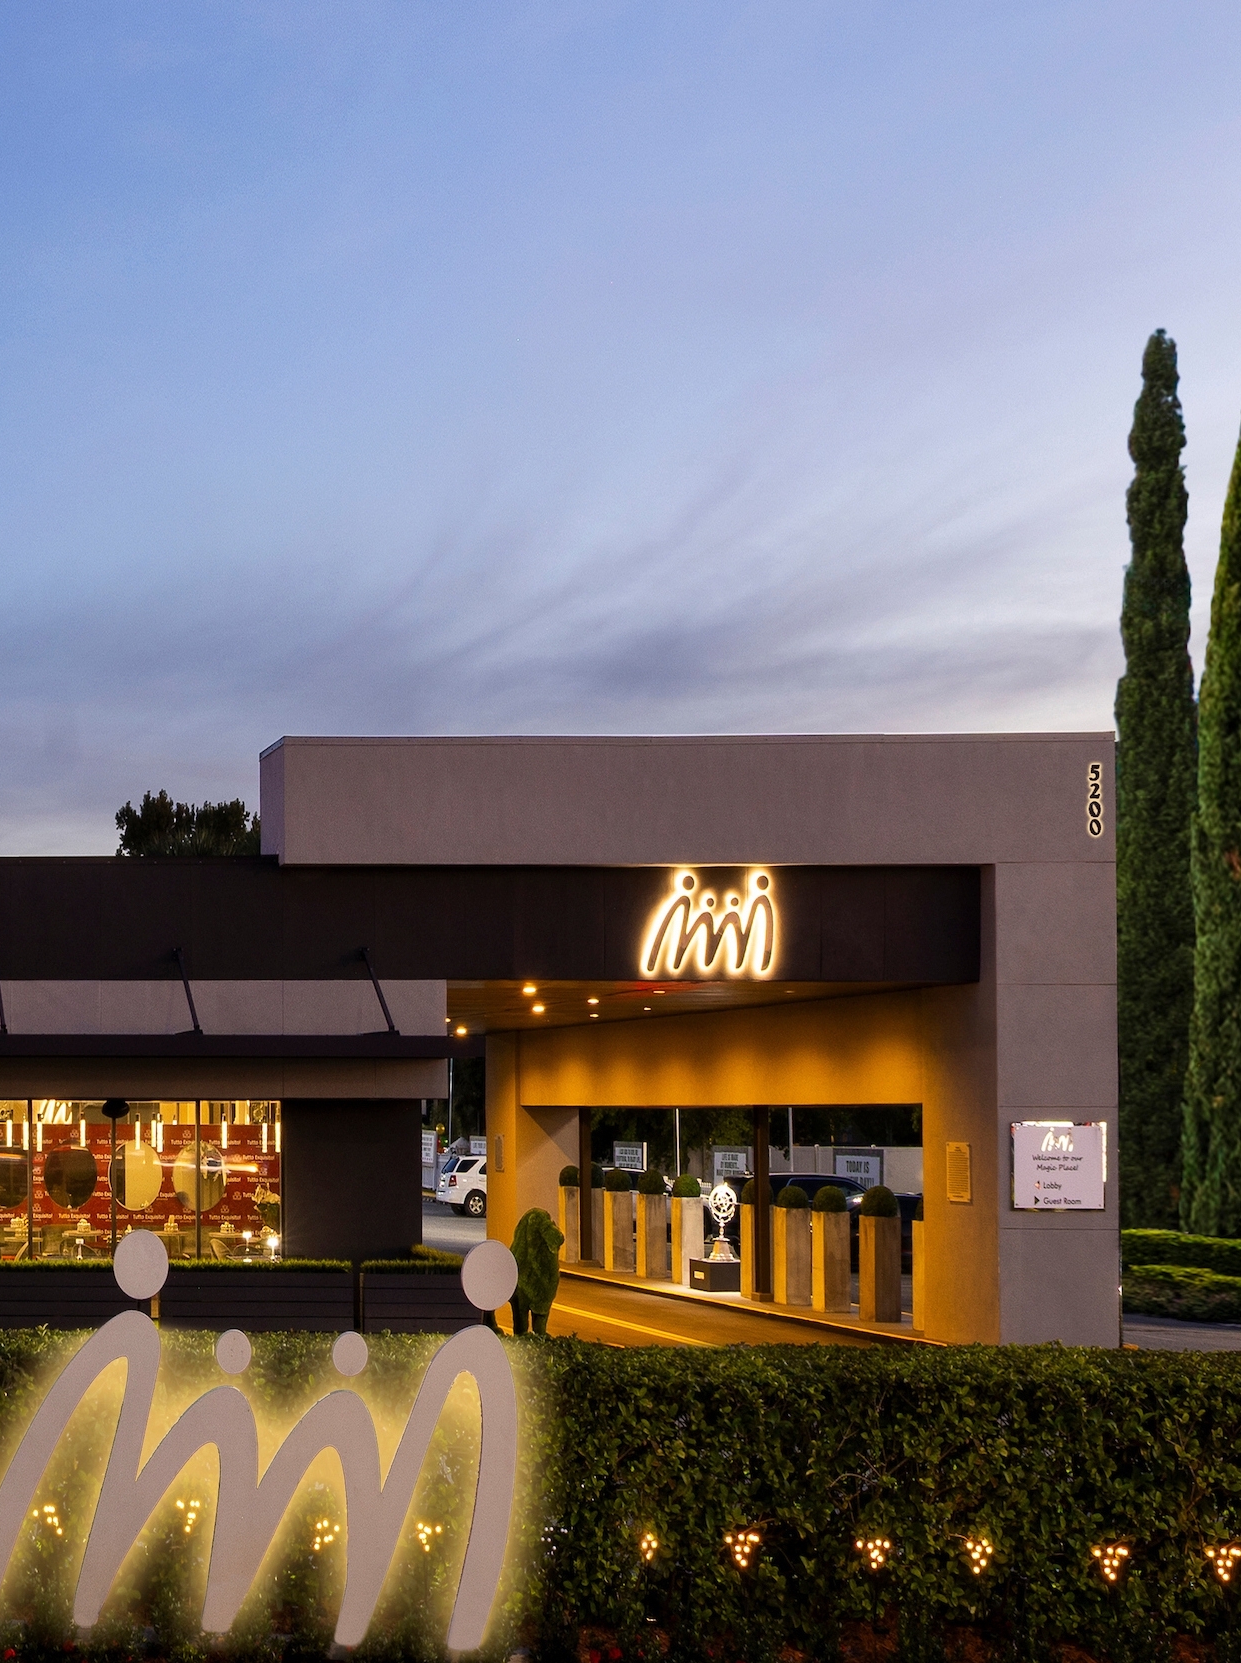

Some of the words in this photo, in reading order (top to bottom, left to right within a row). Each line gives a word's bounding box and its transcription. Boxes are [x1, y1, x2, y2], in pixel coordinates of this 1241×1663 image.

[1088, 764, 1102, 836] 5200
[846, 1160, 862, 1173] TODAY
[863, 1161, 870, 1174] IS
[1036, 1163, 1057, 1173] Magic
[1043, 1181, 1062, 1191] Lobby
[1043, 1196, 1062, 1205] Guest
[1063, 1196, 1082, 1205] Room
